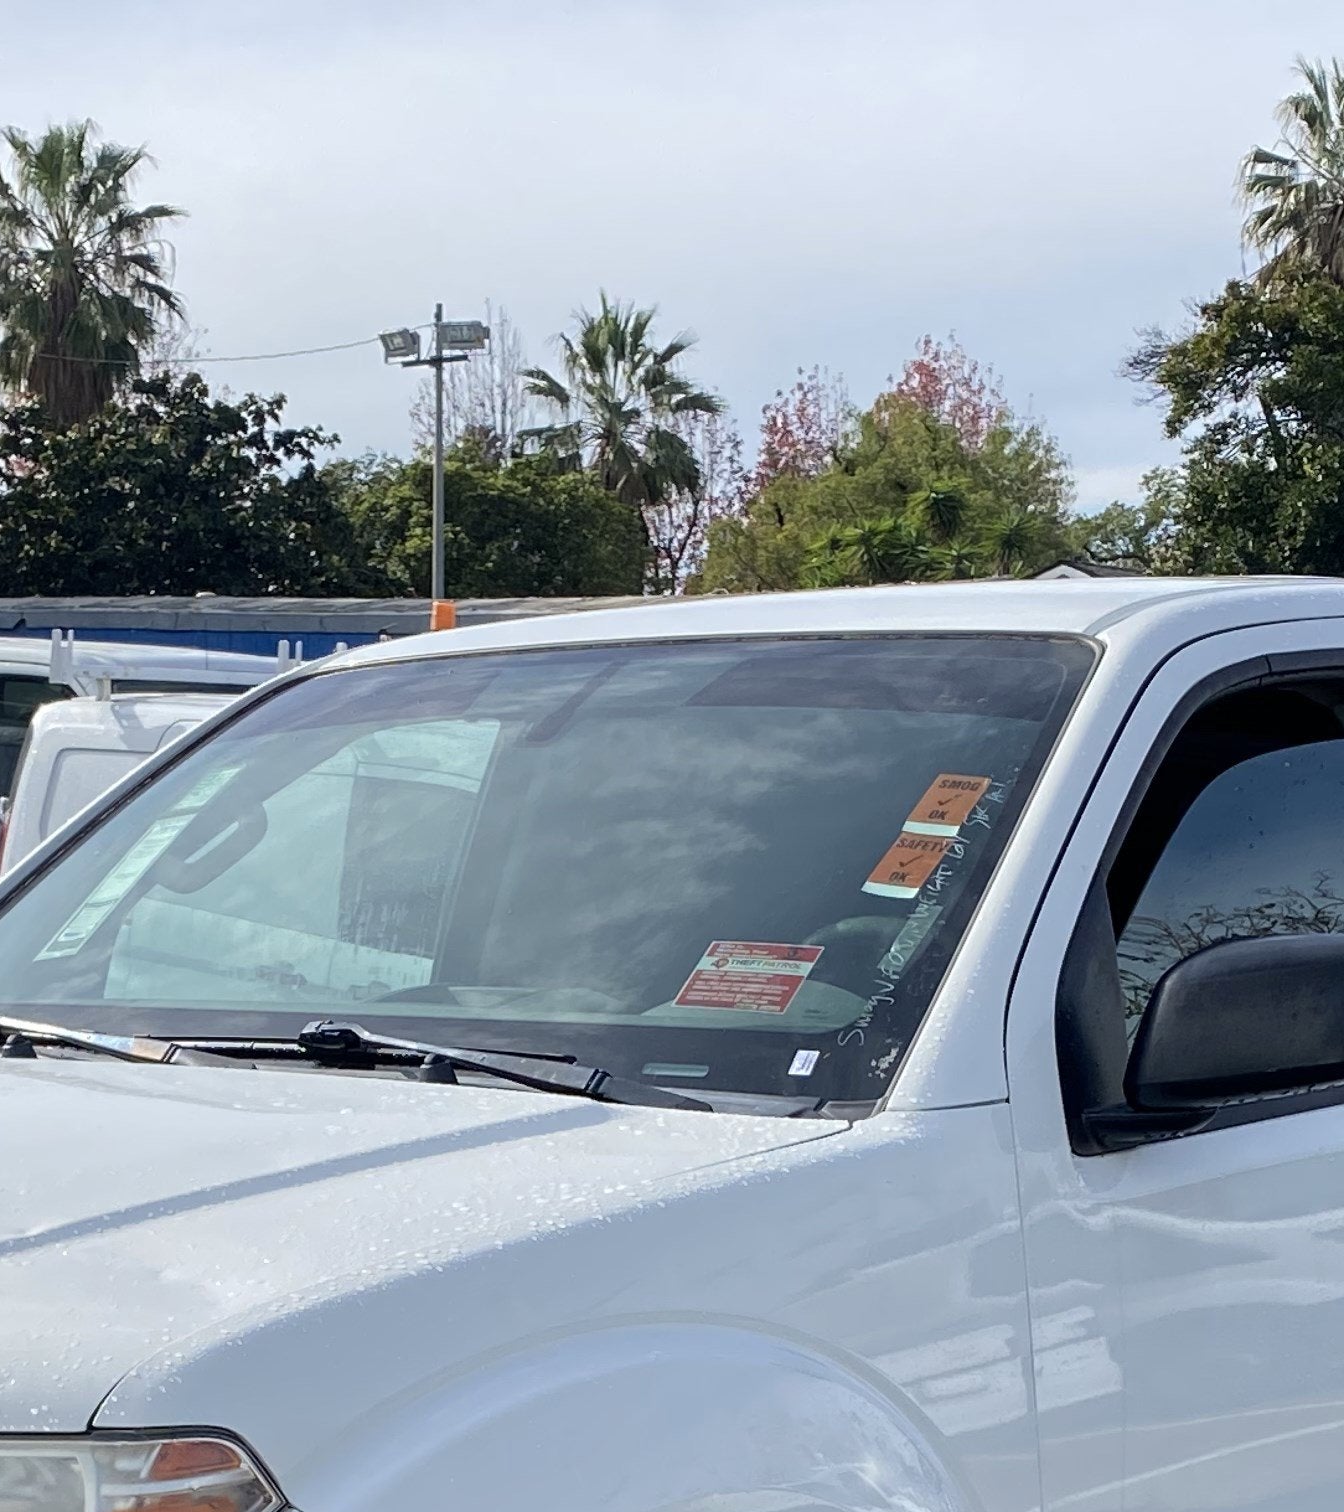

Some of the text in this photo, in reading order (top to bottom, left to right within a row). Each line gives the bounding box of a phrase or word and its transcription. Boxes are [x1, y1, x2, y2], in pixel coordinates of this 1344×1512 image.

[938, 779, 981, 792] SMOG
[928, 809, 948, 821] OK
[896, 838, 946, 853] SAFETY
[889, 872, 910, 883] OK
